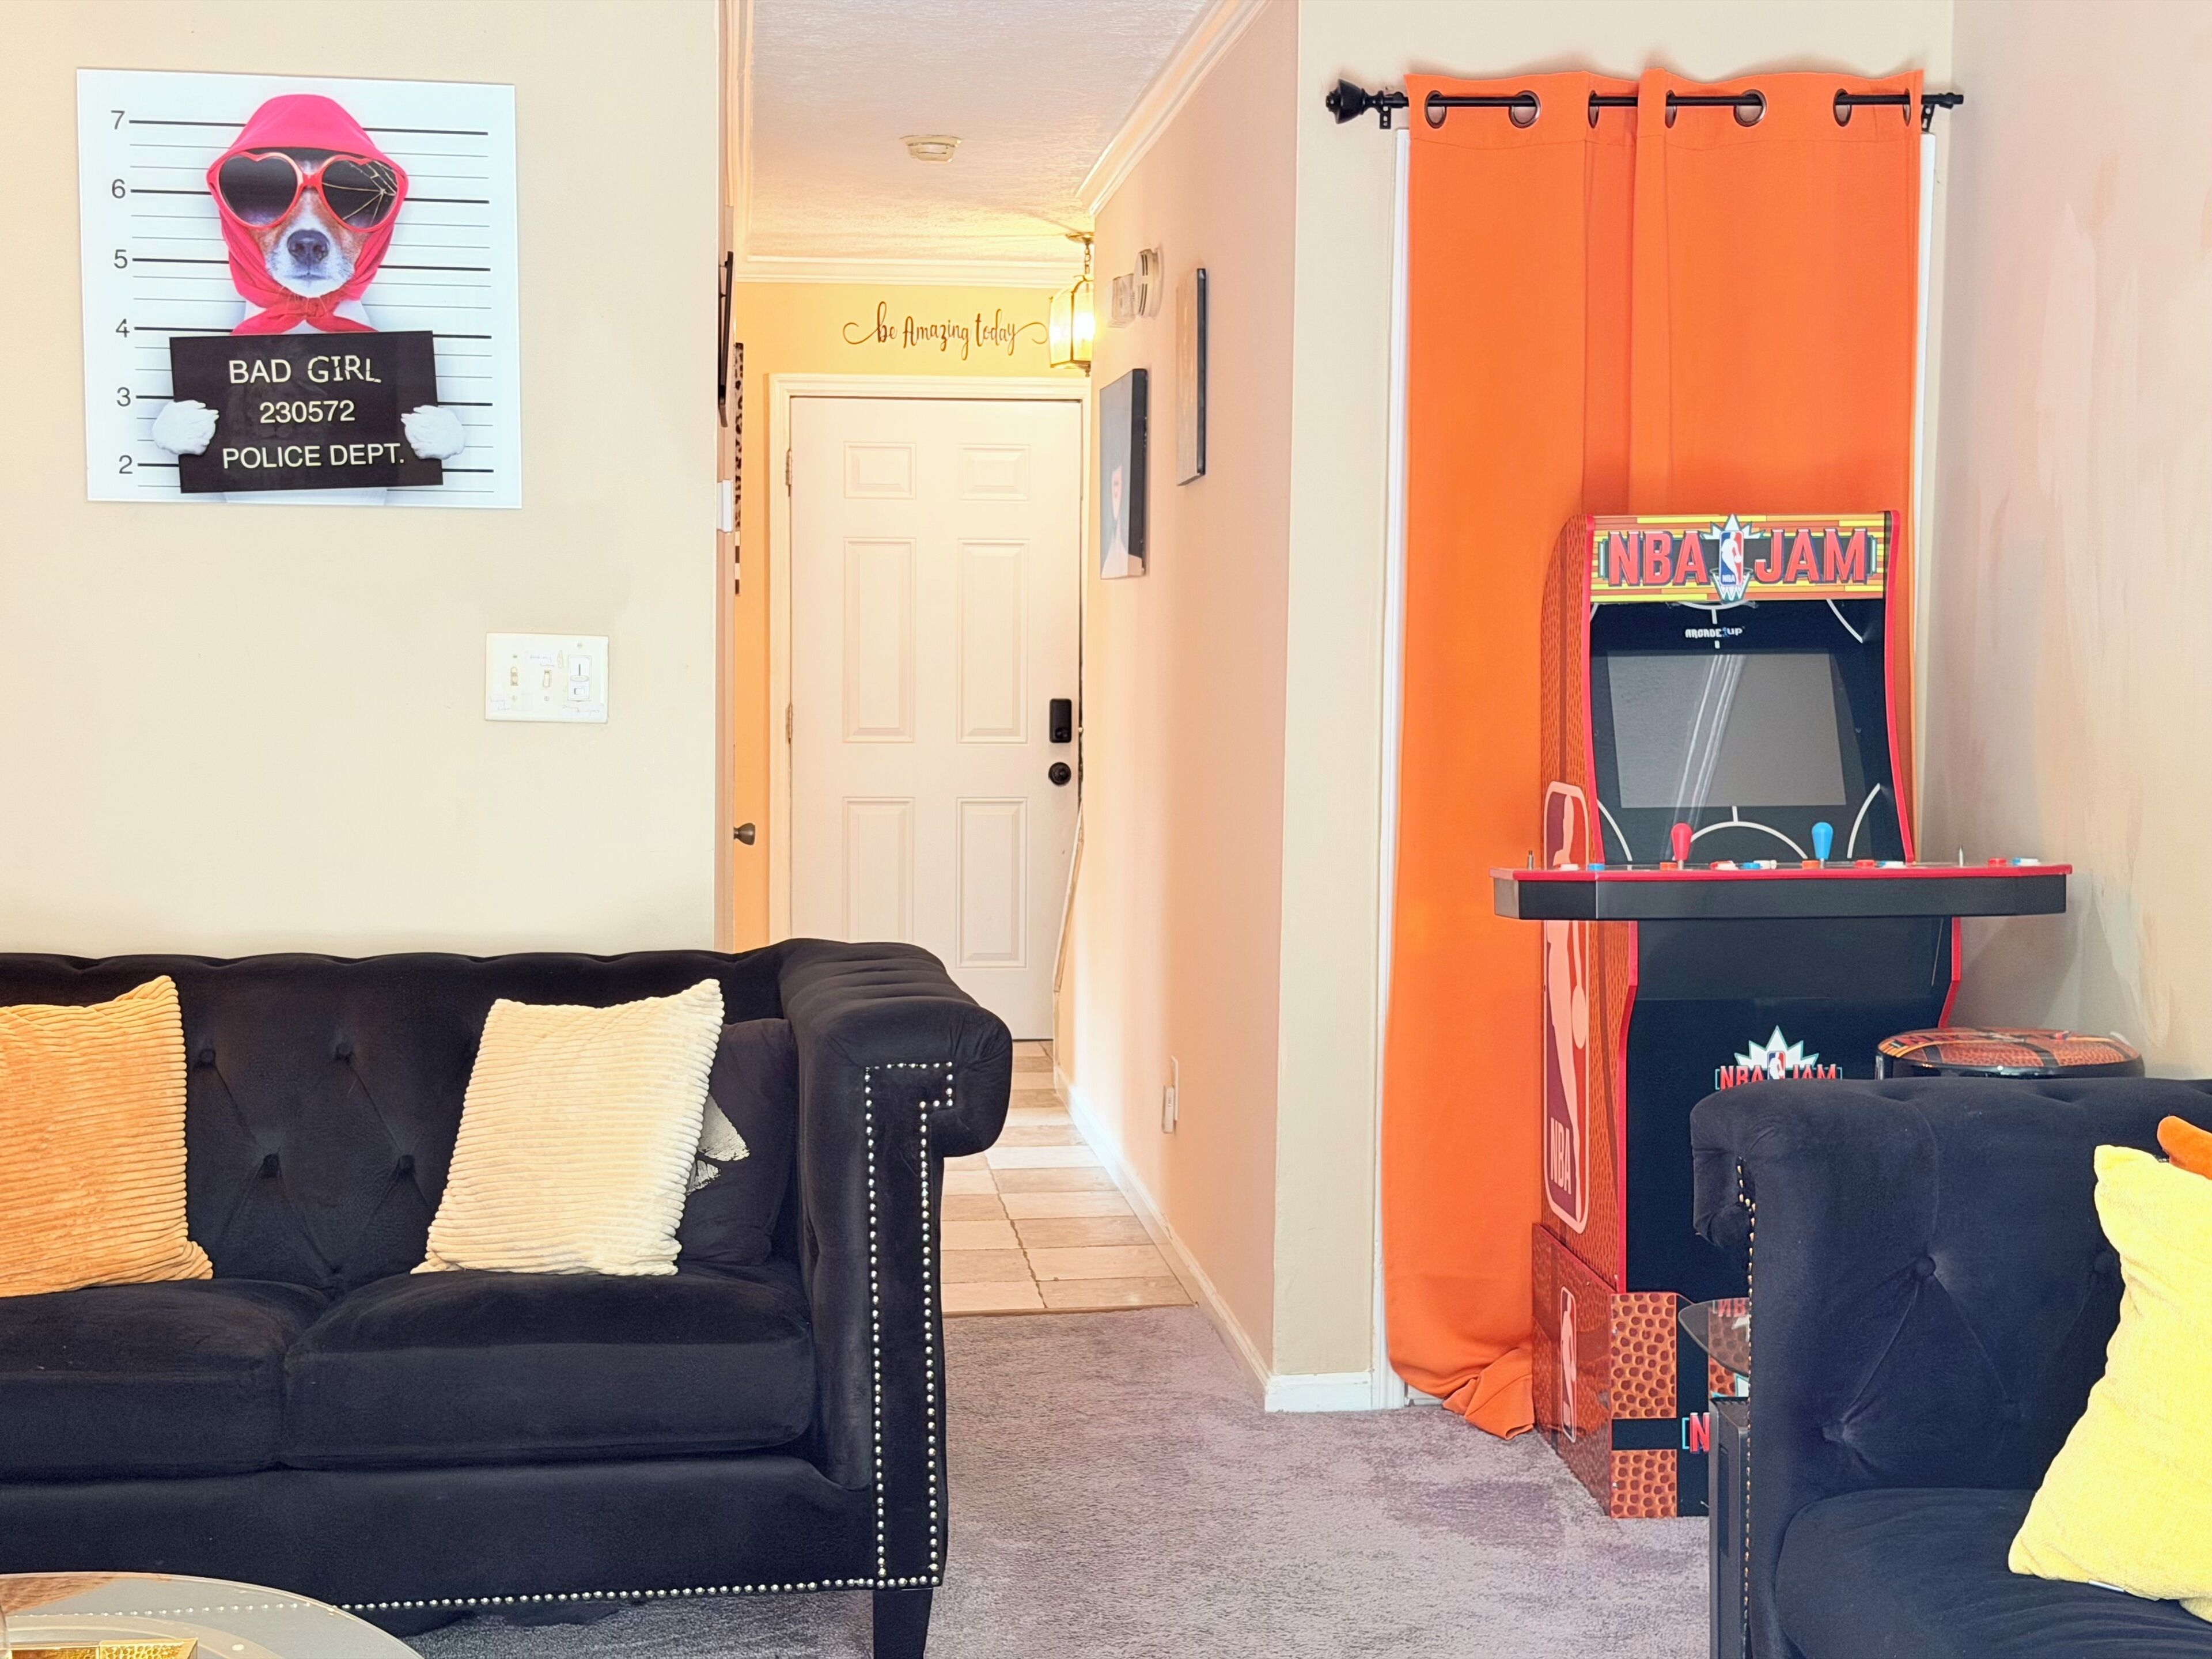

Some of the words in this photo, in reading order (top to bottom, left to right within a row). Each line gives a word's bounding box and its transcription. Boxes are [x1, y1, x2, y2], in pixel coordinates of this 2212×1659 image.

[111, 110, 125, 130] 7
[111, 179, 126, 199] 6
[113, 249, 128, 268] 5
[115, 319, 130, 338] 4
[902, 316, 969, 361] Amazing
[229, 359, 291, 384] BAD
[308, 355, 381, 383] GIRL
[116, 387, 131, 407] 3
[260, 400, 355, 423] 230572
[119, 454, 133, 474] 2
[223, 445, 321, 469] POLICE
[329, 443, 404, 465] DEPT.
[1608, 530, 1711, 586] NBA
[1755, 528, 1867, 584] JAM
[1550, 1116, 1571, 1195] NBA
